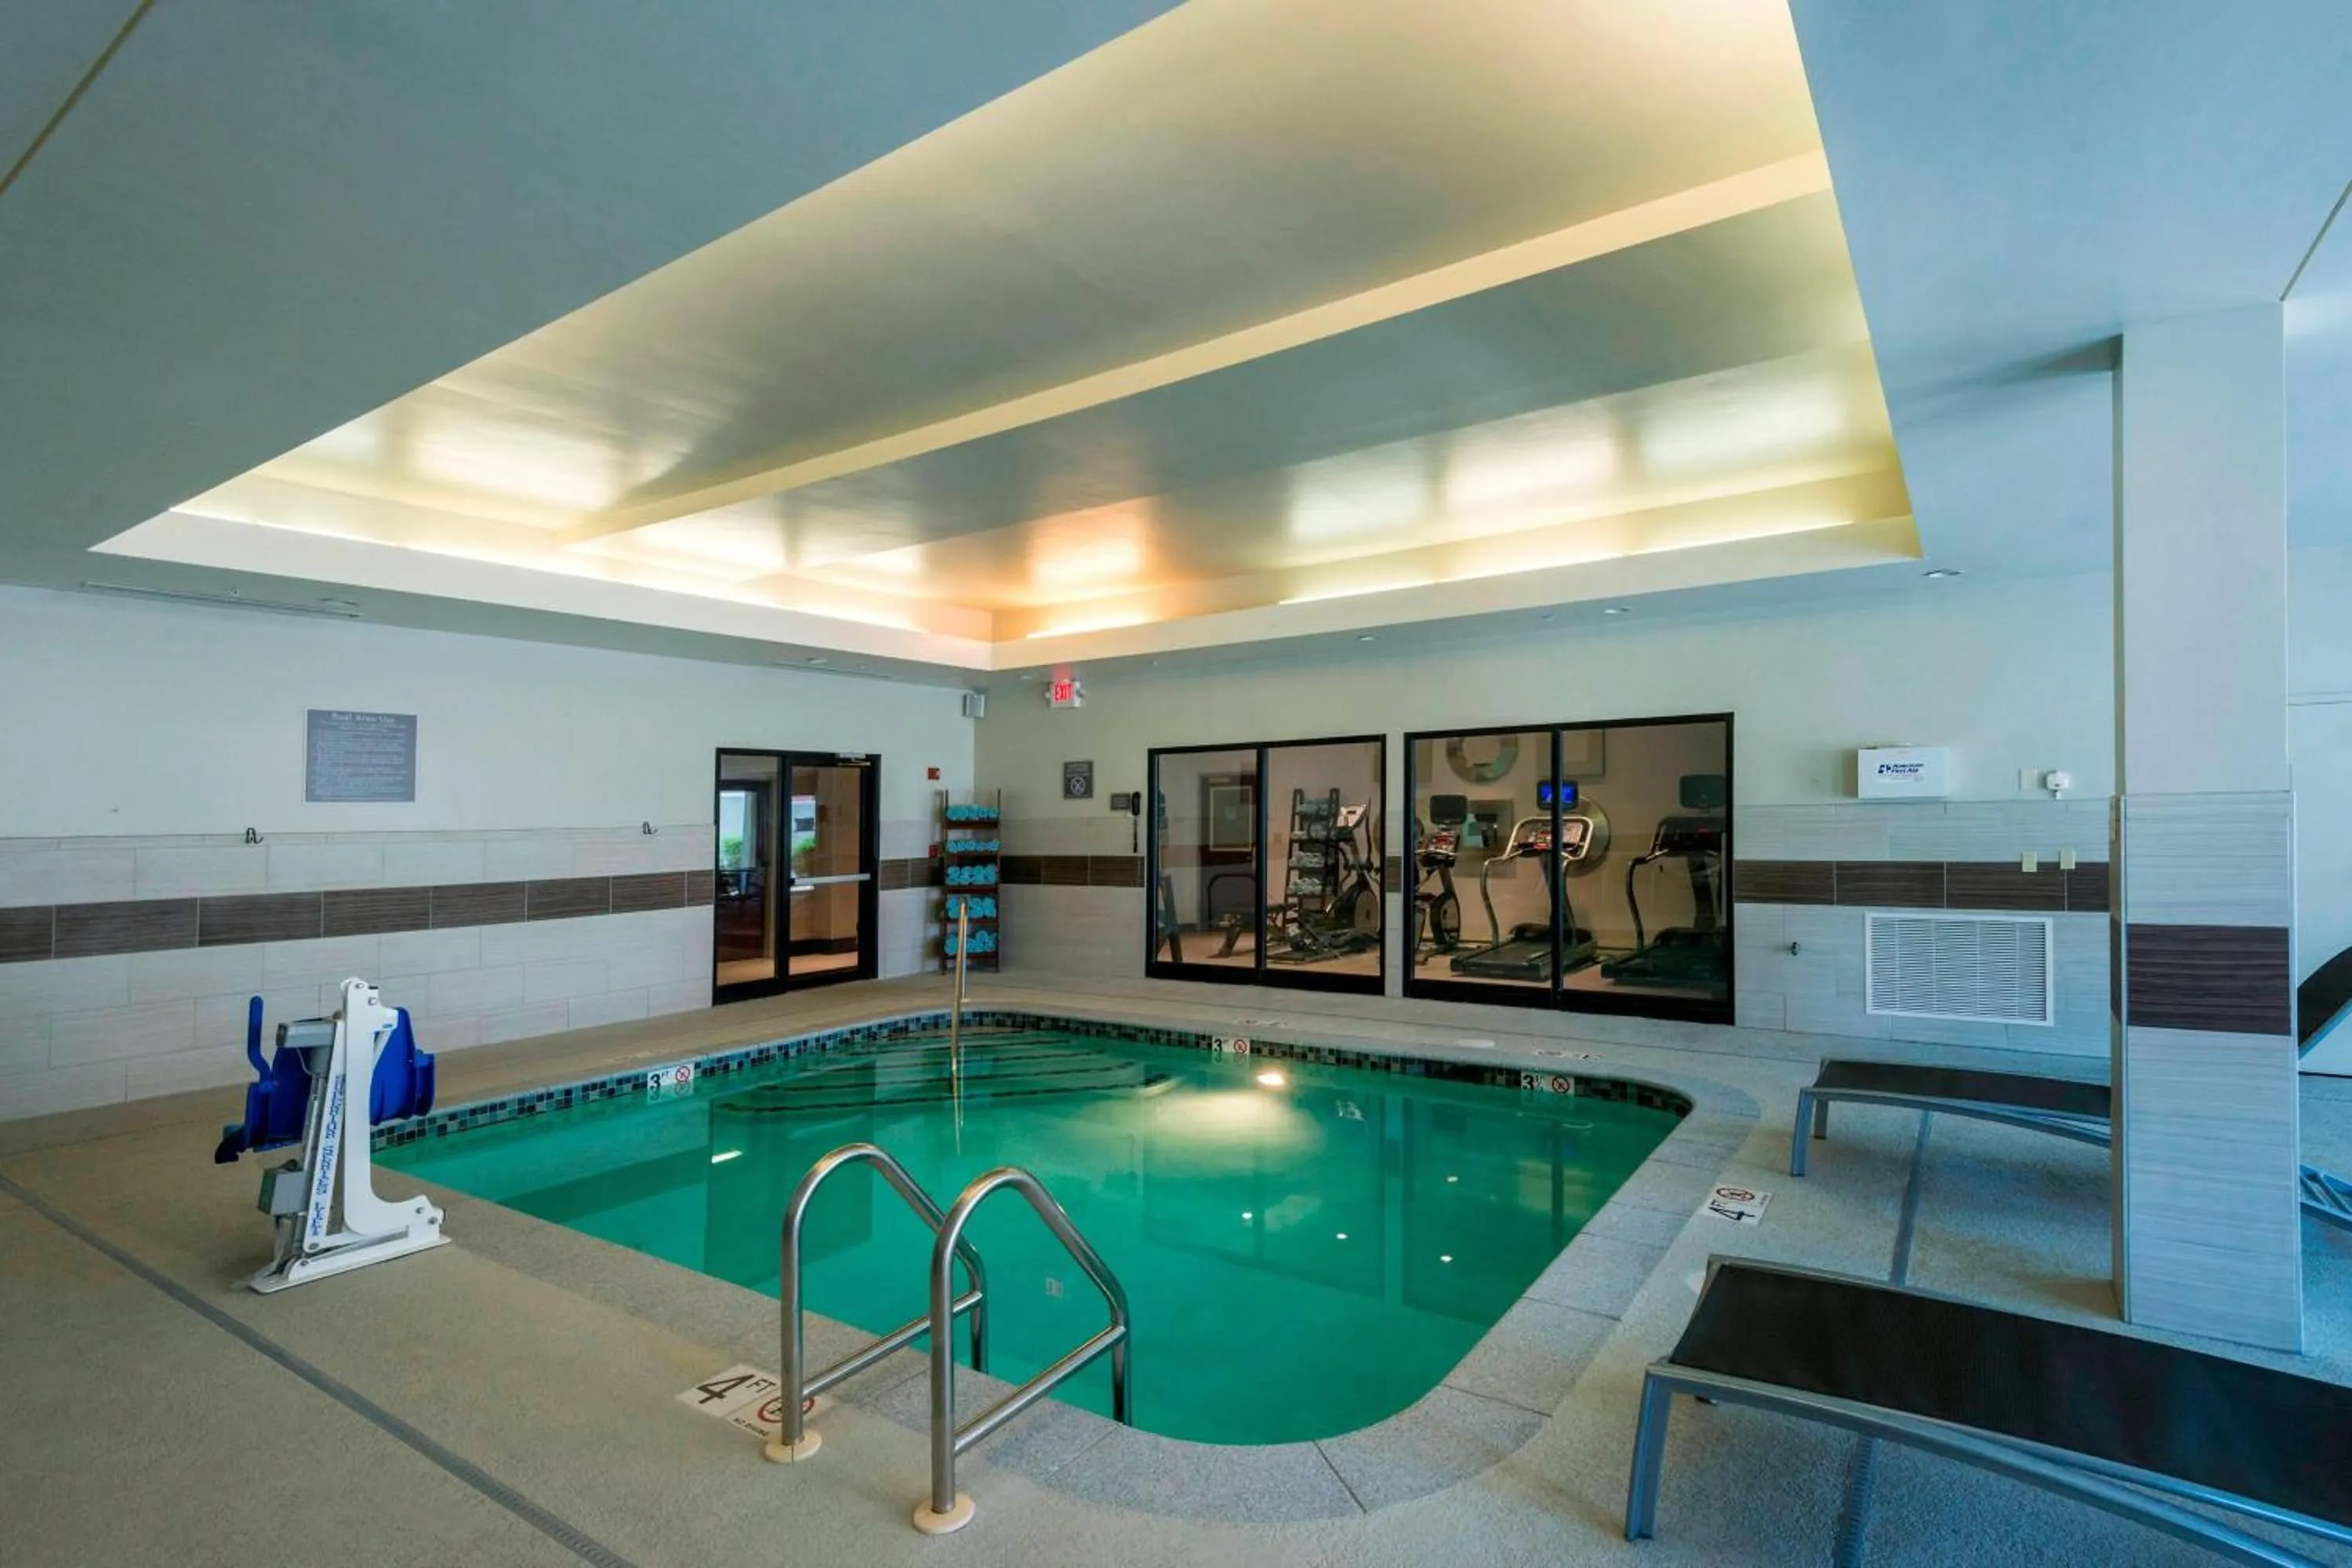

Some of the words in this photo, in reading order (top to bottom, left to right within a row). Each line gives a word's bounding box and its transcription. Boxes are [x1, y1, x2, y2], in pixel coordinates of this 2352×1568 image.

[1054, 684, 1072, 702] EXIT
[650, 1074, 661, 1091] 3
[1708, 1207, 1755, 1221] 4
[695, 1374, 757, 1404] 4
[746, 1378, 776, 1393] FT
